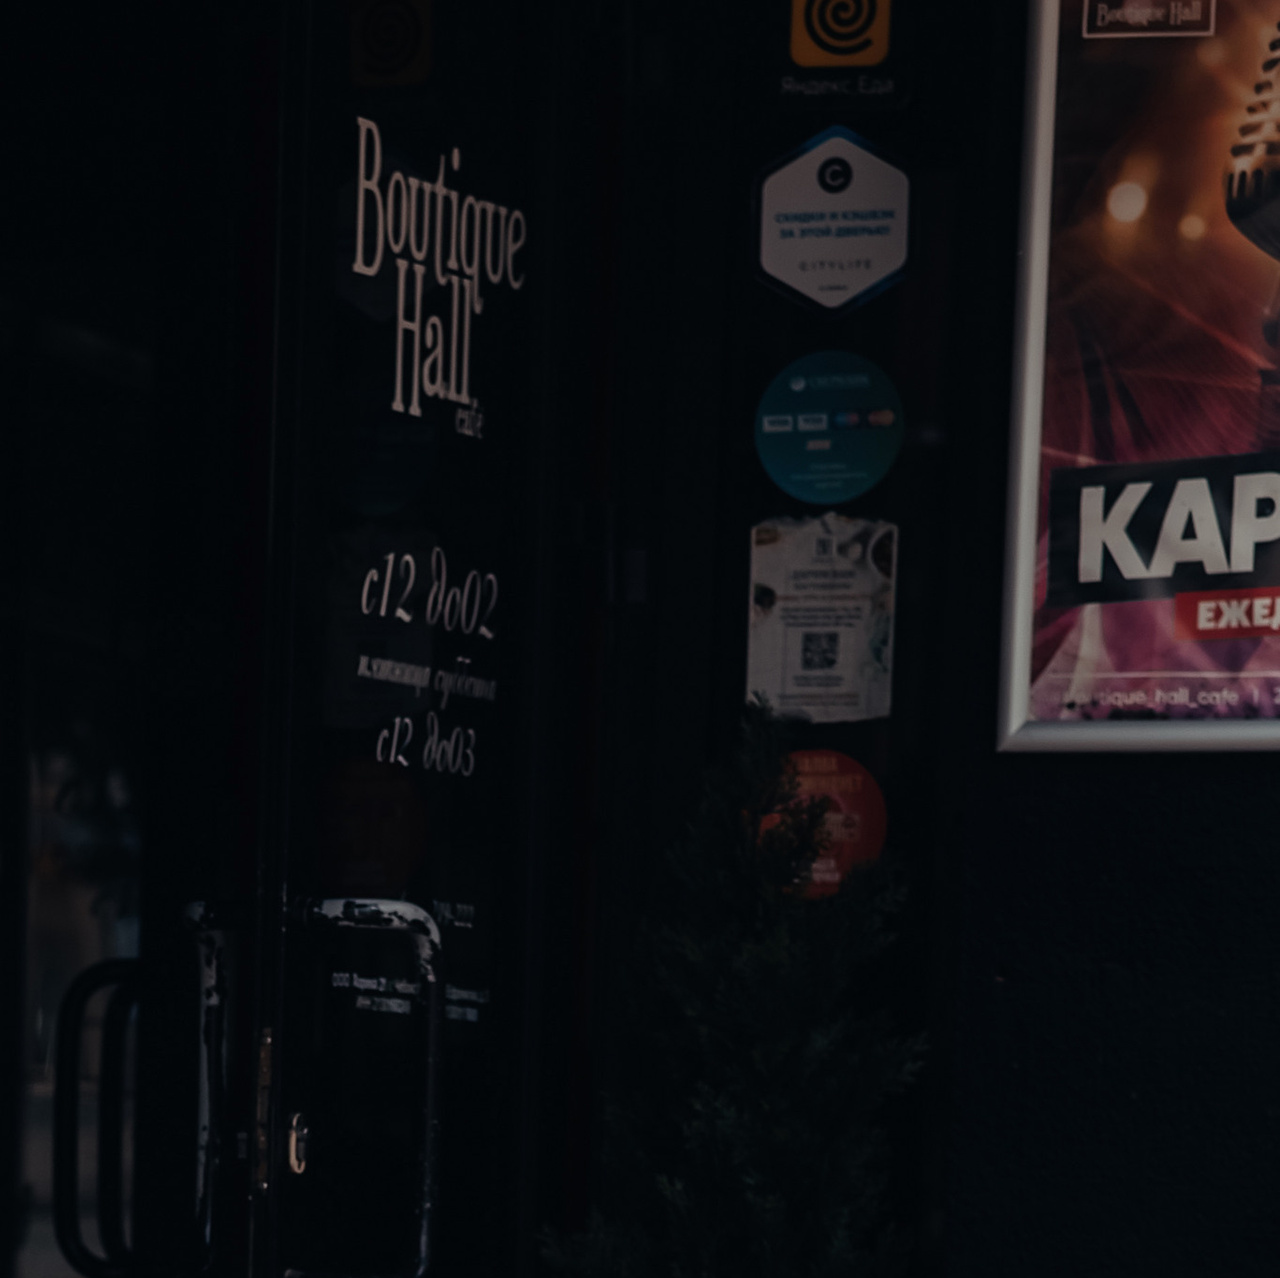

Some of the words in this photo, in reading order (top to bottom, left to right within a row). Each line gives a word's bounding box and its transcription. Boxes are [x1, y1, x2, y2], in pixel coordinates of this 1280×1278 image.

[352, 115, 527, 315] Boutique
[391, 257, 472, 418] Hall
[1078, 471, 1280, 583] КАР
[361, 552, 416, 623] с12
[425, 546, 498, 640] до02
[376, 716, 414, 768] с12
[422, 711, 476, 777] до03
